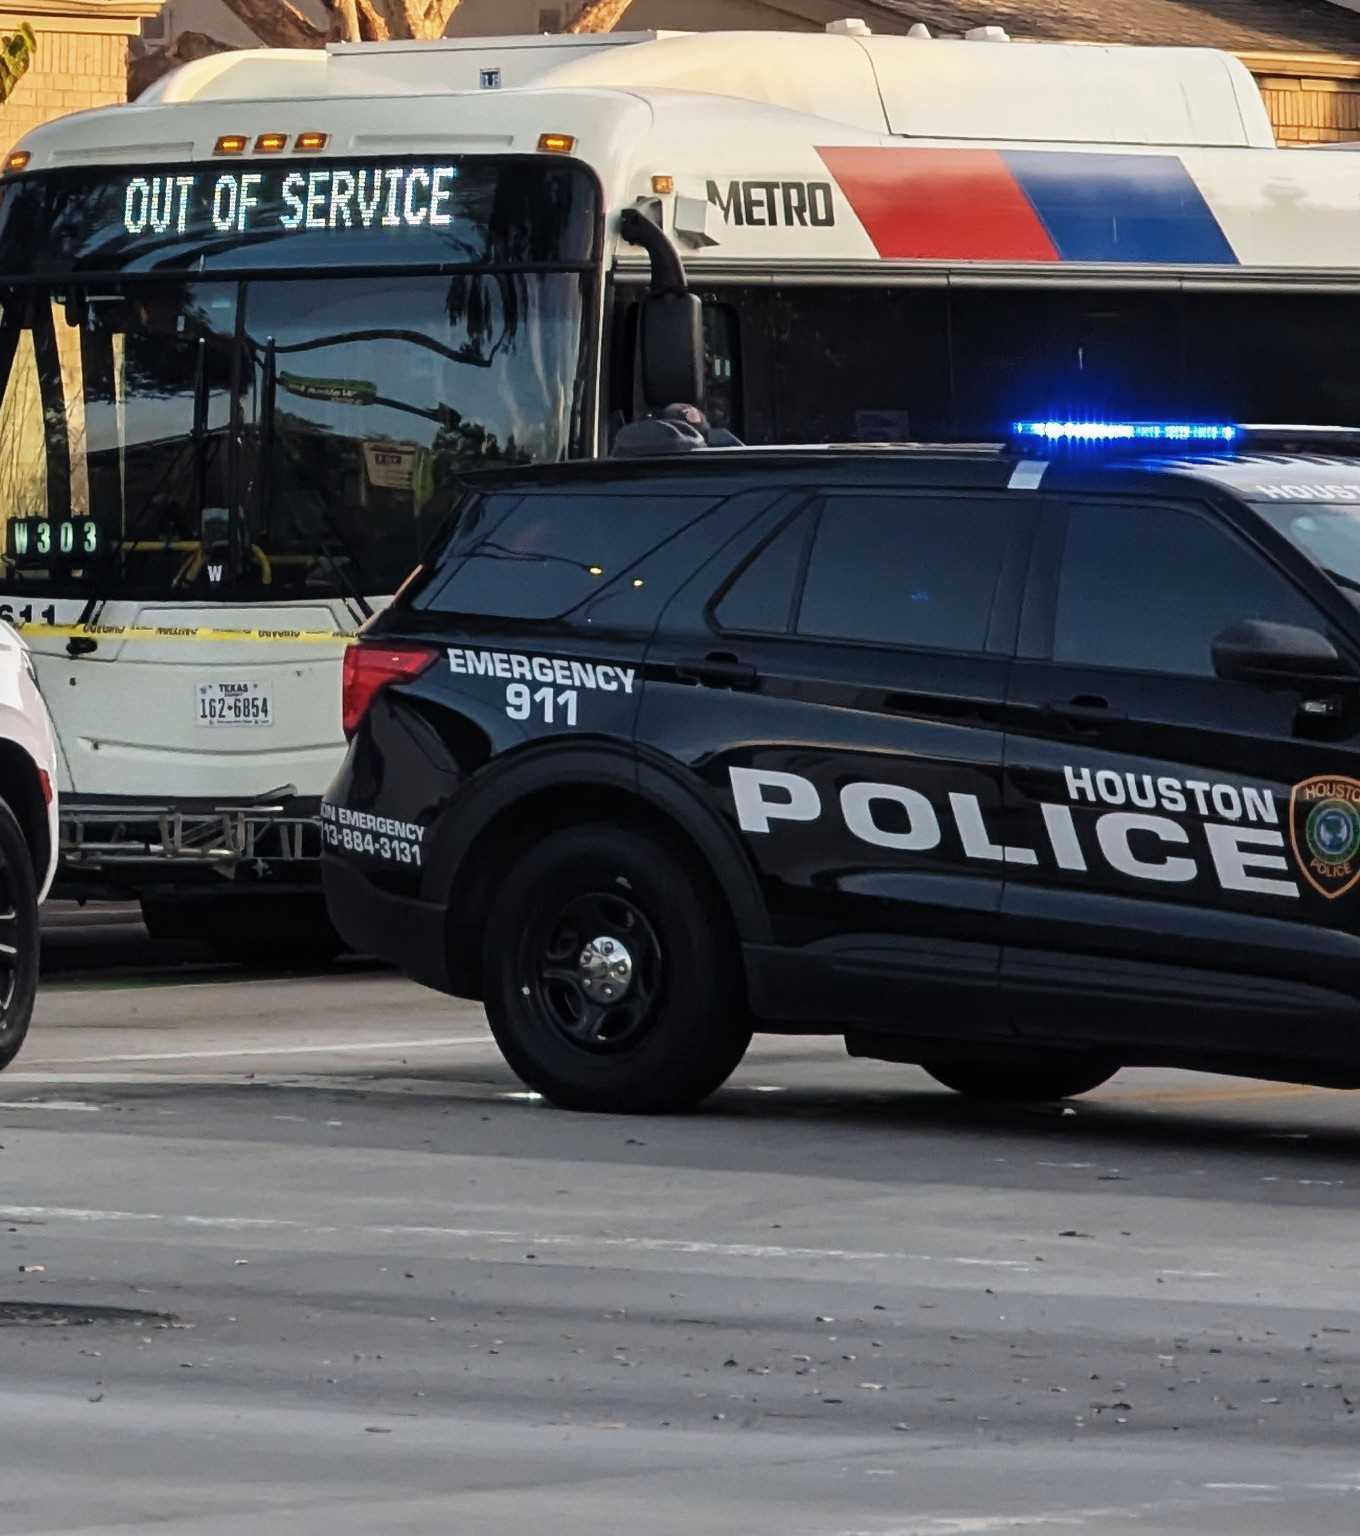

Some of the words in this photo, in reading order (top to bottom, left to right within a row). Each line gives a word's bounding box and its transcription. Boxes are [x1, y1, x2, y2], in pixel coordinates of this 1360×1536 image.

[124, 176, 194, 233] OUT
[211, 173, 262, 232] OF
[280, 166, 455, 229] SERVICE
[706, 179, 835, 227] METRO
[219, 683, 249, 693] TEXAS
[447, 648, 635, 693] EMERGENCY
[506, 683, 578, 726] 911
[1064, 766, 1279, 824] HOUSTON
[338, 807, 425, 842] EMERGENCY
[729, 766, 1300, 898] POLICE
[1310, 858, 1352, 877] POLICE
